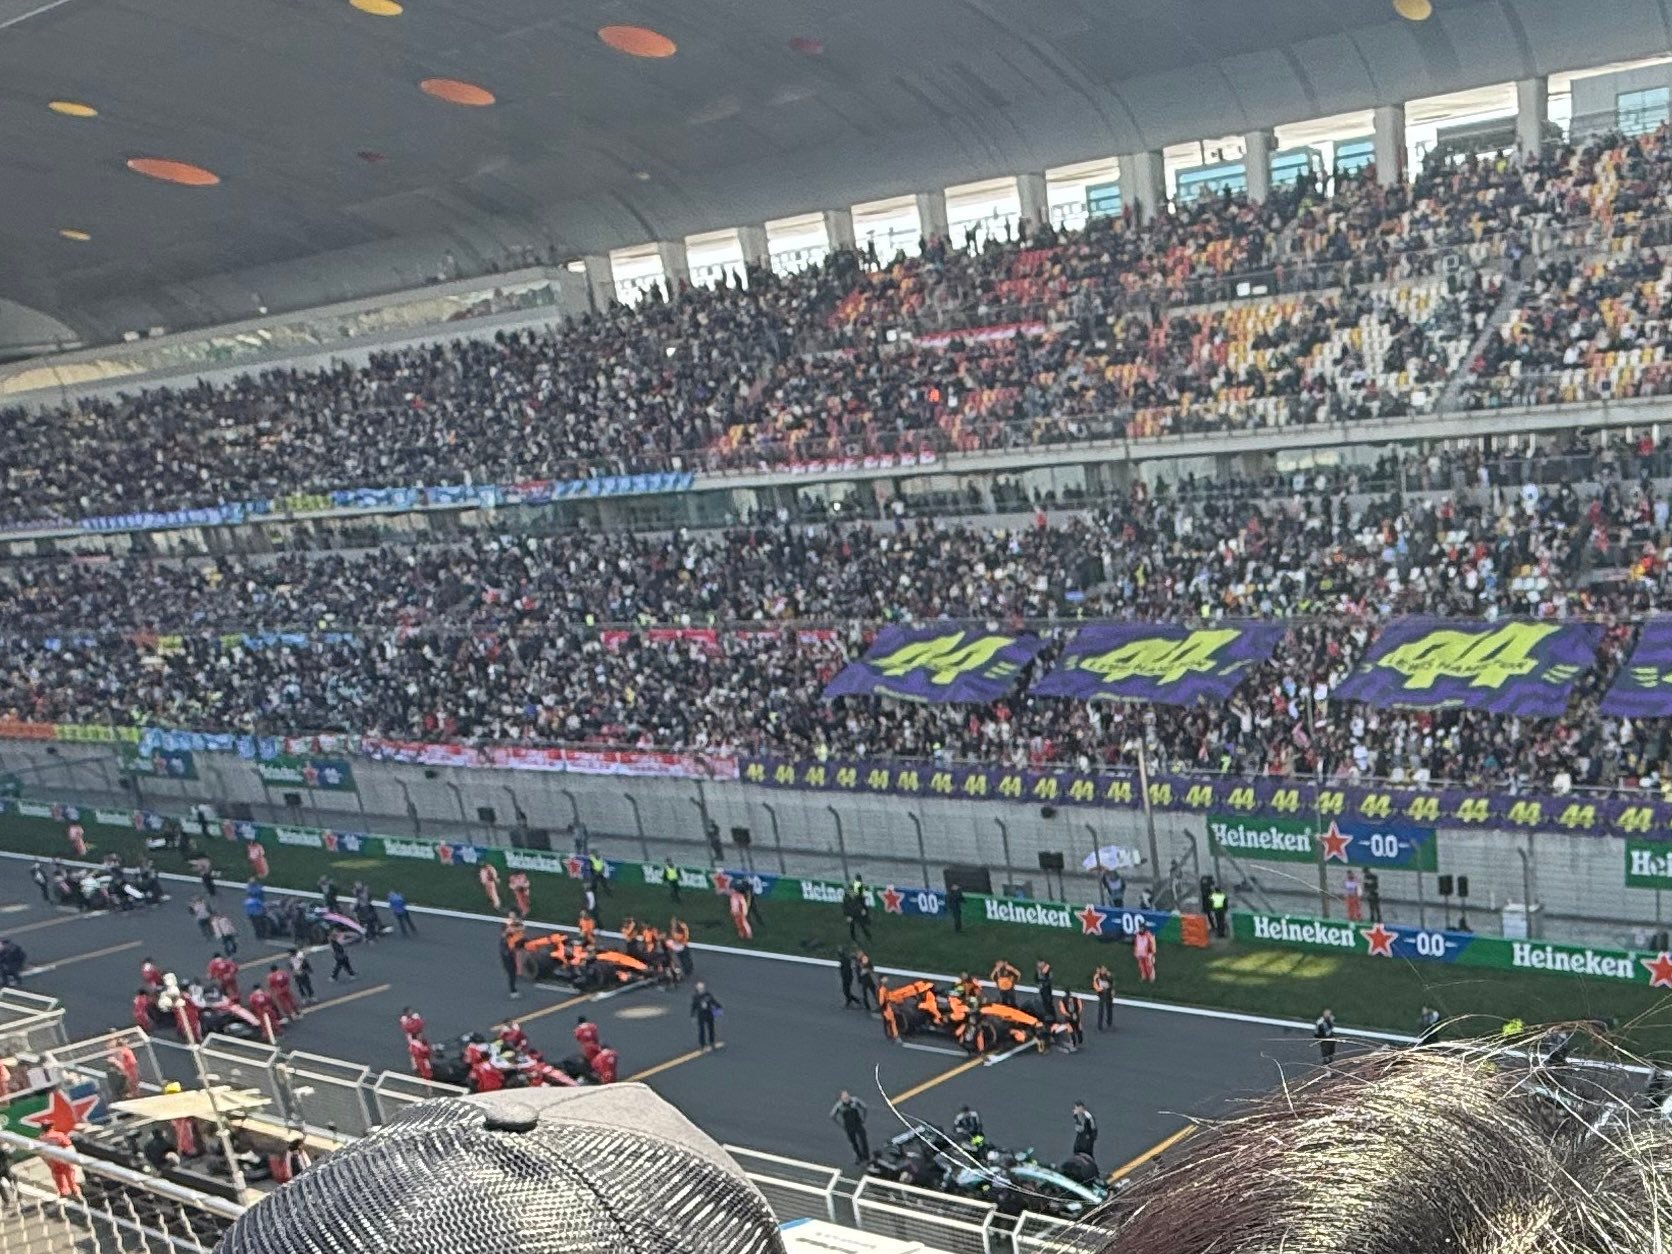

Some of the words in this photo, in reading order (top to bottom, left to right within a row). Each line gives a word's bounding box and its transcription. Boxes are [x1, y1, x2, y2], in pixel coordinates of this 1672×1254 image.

[1079, 629, 1242, 686] 44
[1377, 622, 1562, 689] 44
[836, 767, 857, 786] 44
[868, 770, 889, 788] 44
[898, 771, 919, 790] 44
[930, 773, 953, 792] 44
[964, 774, 987, 794] 44
[999, 776, 1022, 796] 44
[1034, 777, 1058, 798] 44
[1070, 779, 1095, 800] 44
[1107, 780, 1132, 801] 44
[1144, 783, 1172, 805] 44
[1185, 785, 1213, 806] 44
[1227, 787, 1256, 809] 44
[1271, 789, 1300, 811] 44
[1316, 790, 1345, 814] 44
[1359, 793, 1391, 817] 44
[1407, 796, 1440, 820] 44
[1455, 798, 1490, 822] 44
[1508, 800, 1541, 825] 44
[1559, 803, 1596, 828] 44
[1616, 806, 1653, 832] 44
[1211, 823, 1311, 853] Heineken
[985, 898, 1073, 928] Heineken
[1253, 916, 1356, 948] Heineken
[1512, 943, 1636, 979] Heineken
